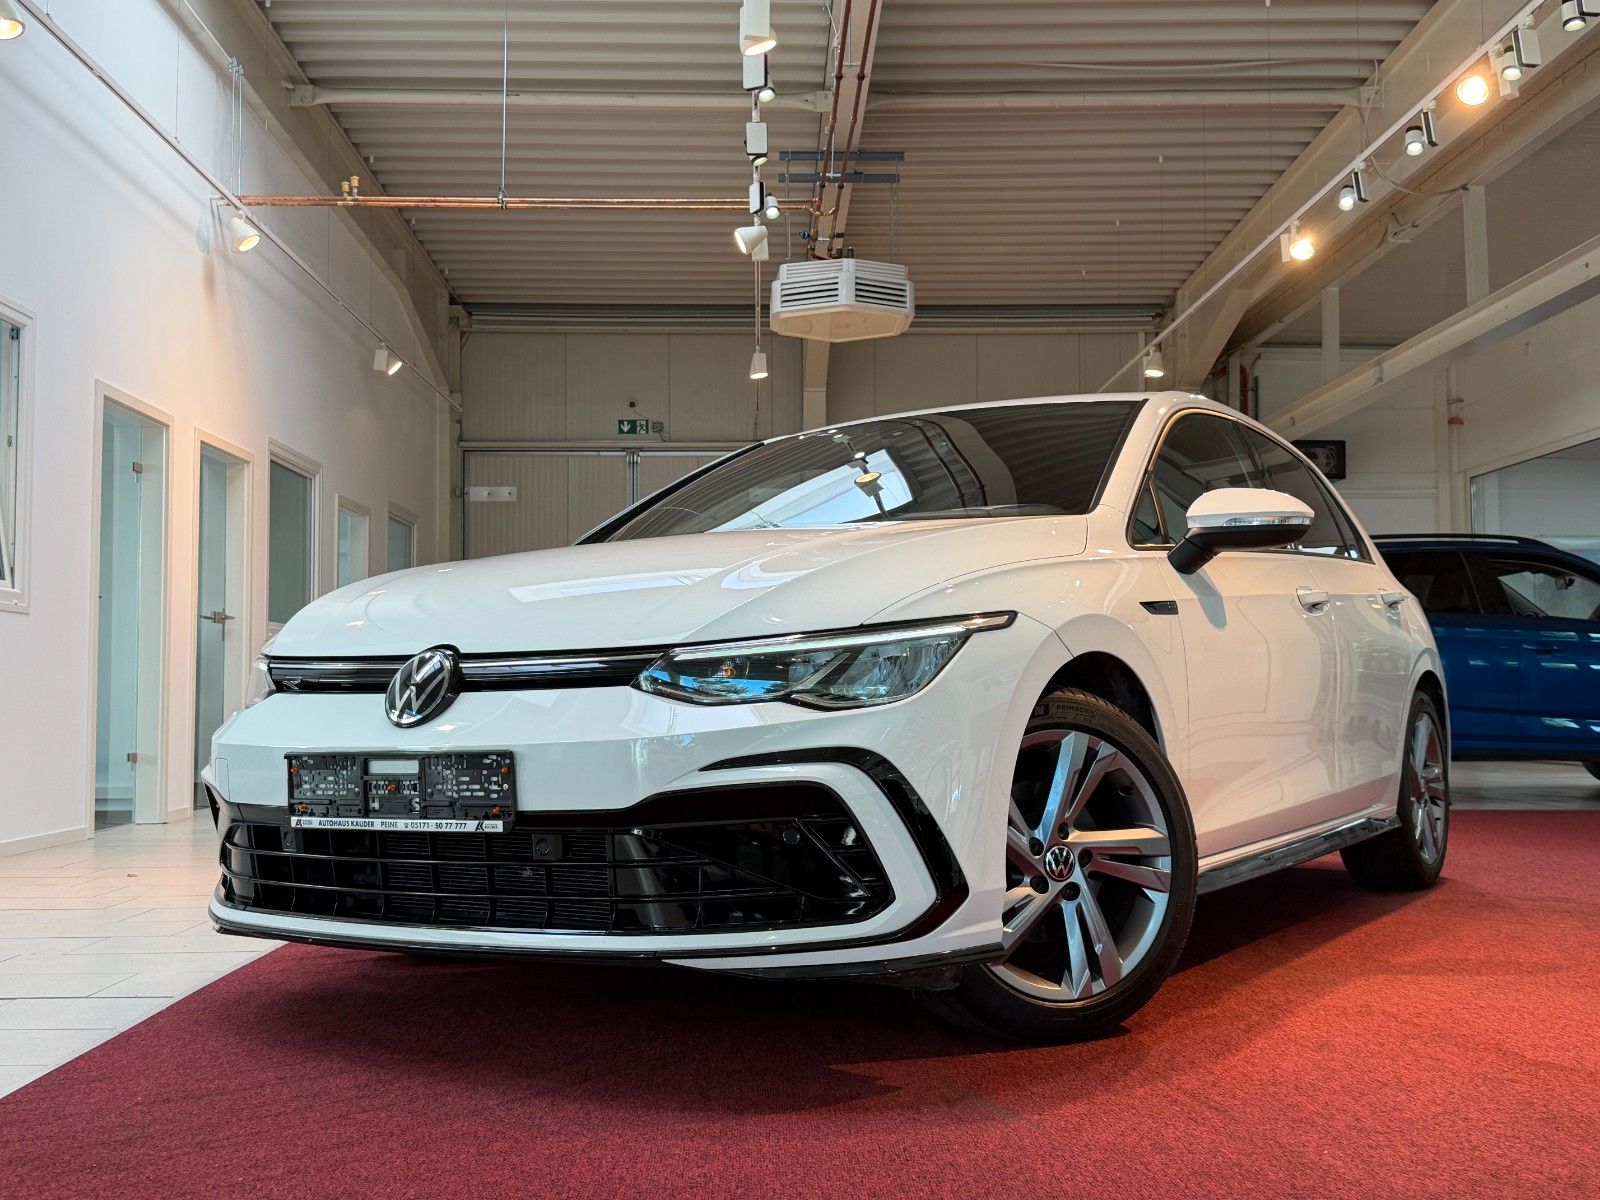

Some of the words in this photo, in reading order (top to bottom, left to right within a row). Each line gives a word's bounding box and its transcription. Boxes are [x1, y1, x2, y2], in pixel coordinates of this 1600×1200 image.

[1056, 704, 1091, 716] PRIMACY
[318, 819, 350, 828] AUTOHAUS
[351, 820, 375, 828] KAUDER
[380, 821, 398, 829] PEINE
[410, 821, 430, 829] 05171
[435, 822, 443, 830] 50
[444, 822, 453, 830] 77
[454, 822, 468, 830] 777
